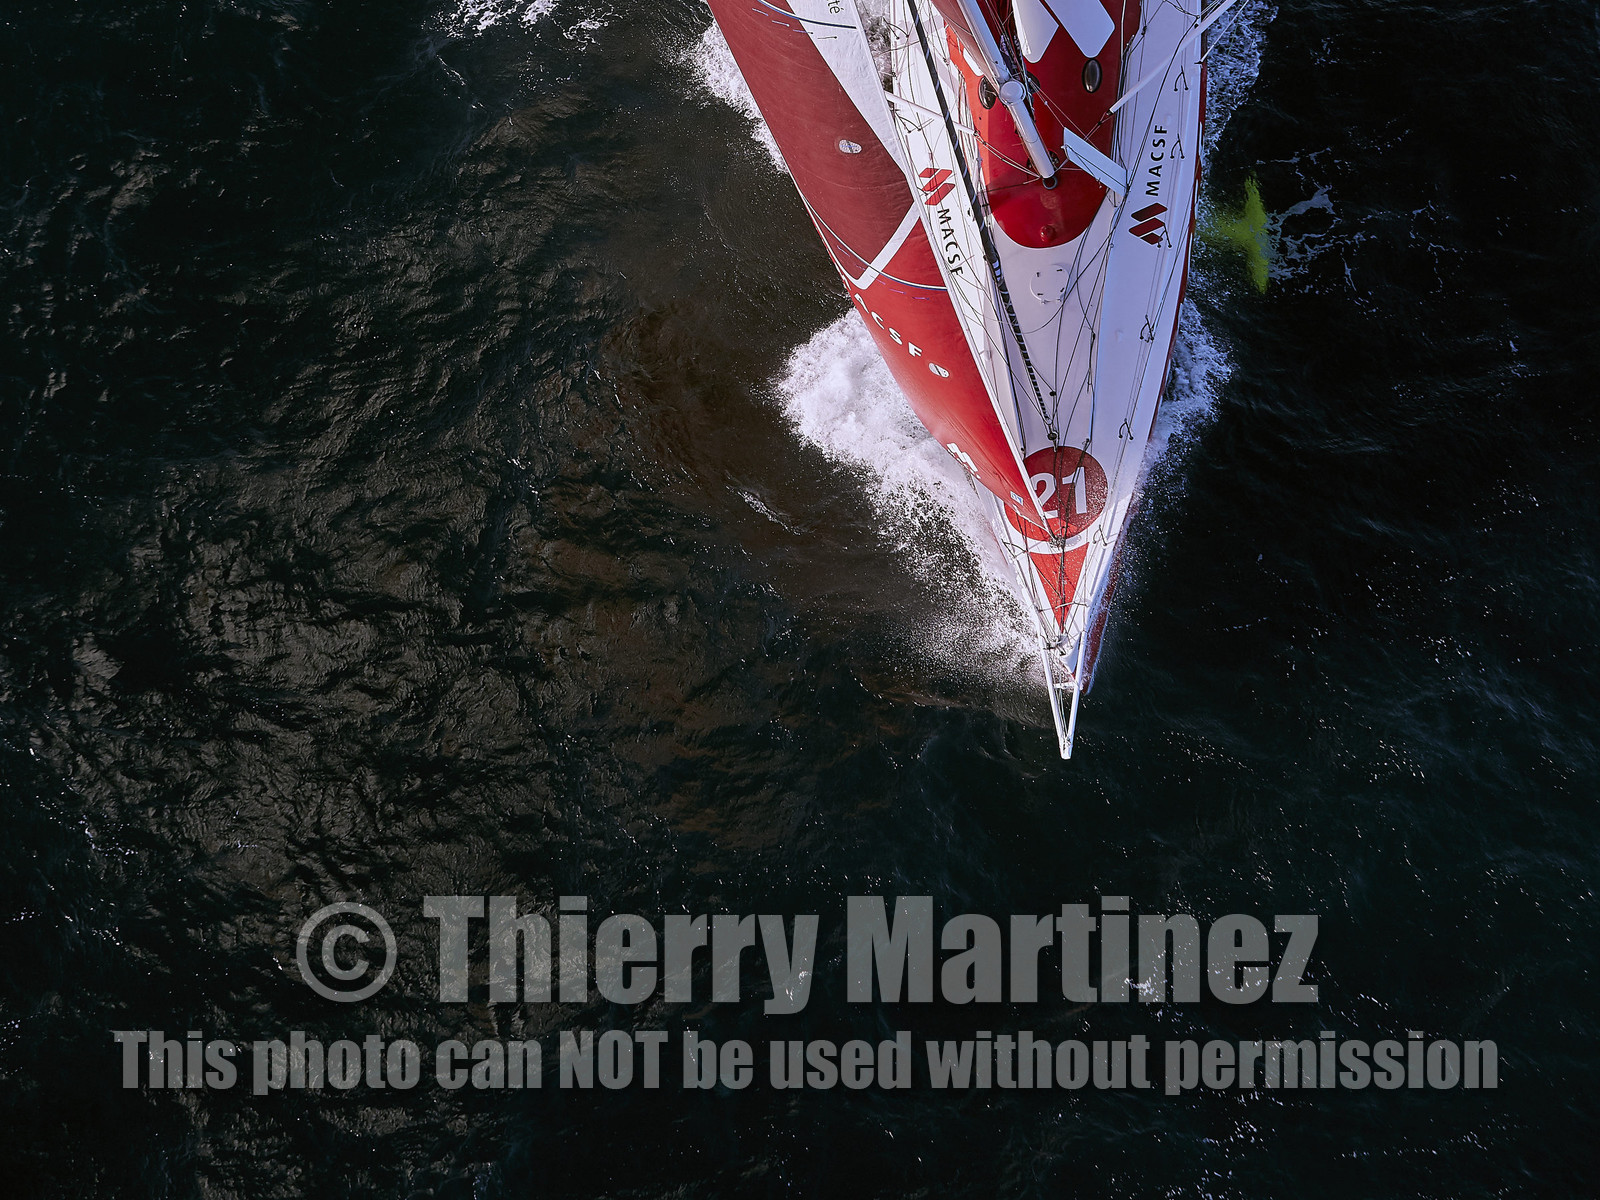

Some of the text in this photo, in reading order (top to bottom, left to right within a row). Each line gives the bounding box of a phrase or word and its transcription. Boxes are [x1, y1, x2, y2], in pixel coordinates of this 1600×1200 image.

[1145, 125, 1168, 197] MACSF
[937, 208, 964, 276] MACSF
[1031, 466, 1088, 519] 21
